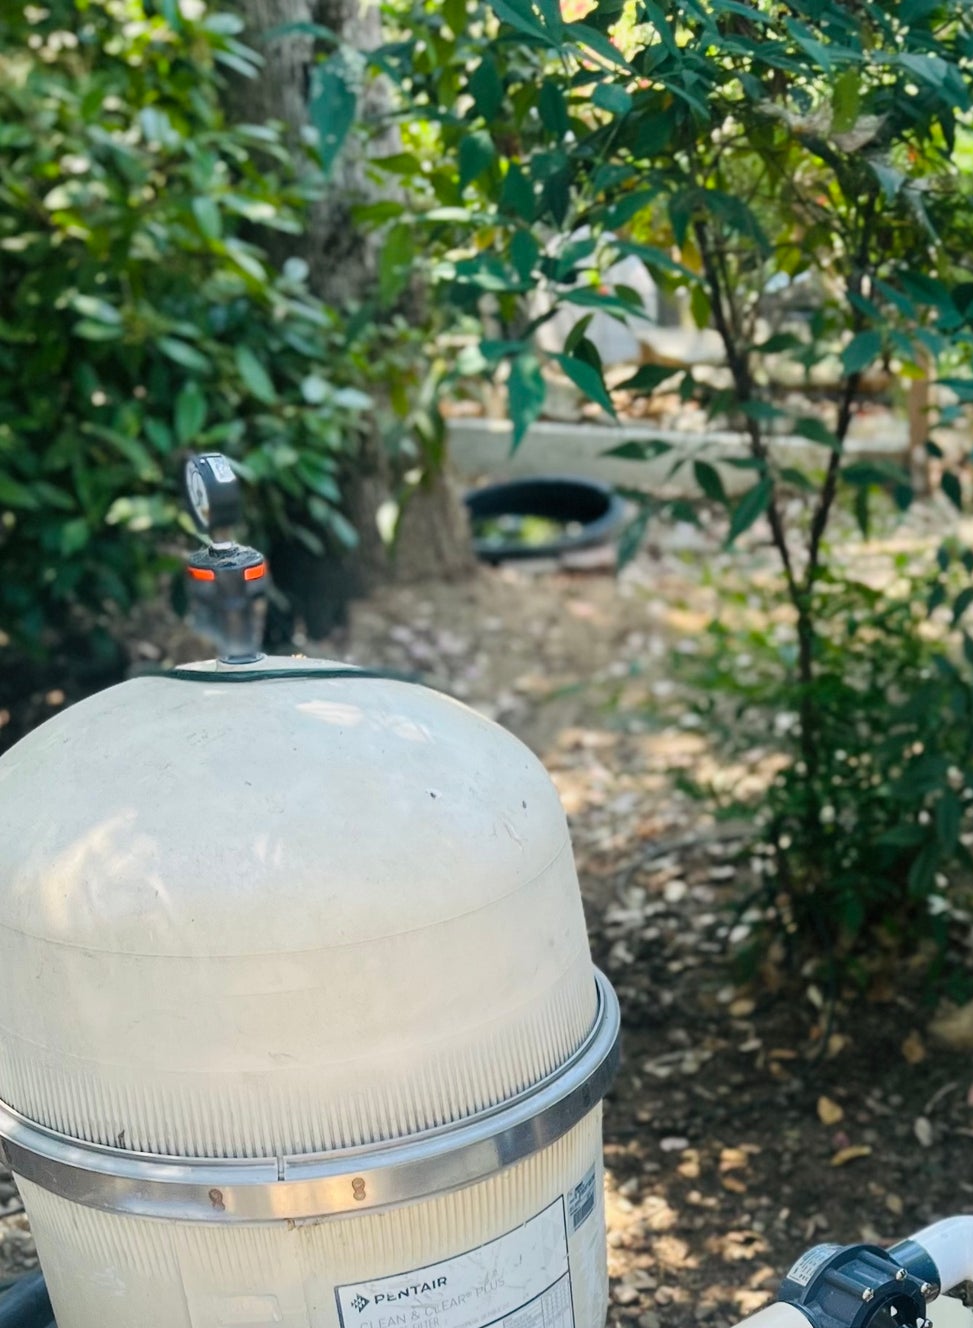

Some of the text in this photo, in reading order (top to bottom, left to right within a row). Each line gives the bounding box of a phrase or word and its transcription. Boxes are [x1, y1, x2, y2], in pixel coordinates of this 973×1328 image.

[374, 1276, 447, 1304] PENTAIR
[410, 1310, 420, 1320] &
[475, 1279, 505, 1297] PLUS
